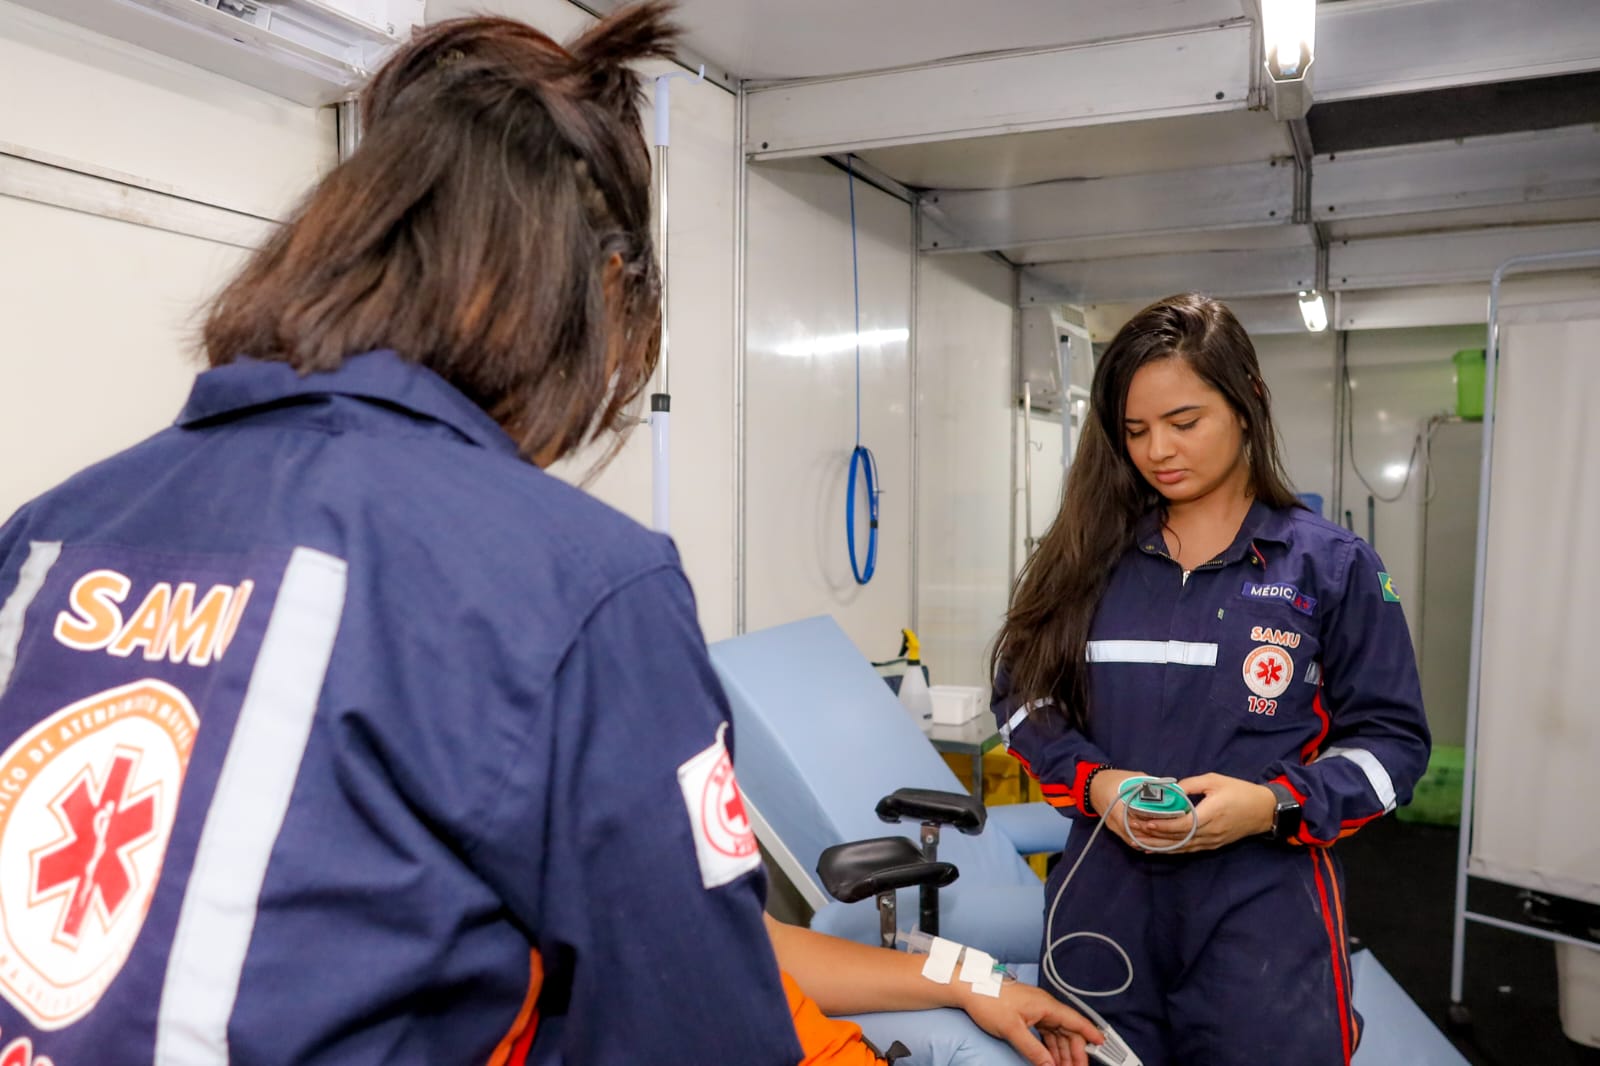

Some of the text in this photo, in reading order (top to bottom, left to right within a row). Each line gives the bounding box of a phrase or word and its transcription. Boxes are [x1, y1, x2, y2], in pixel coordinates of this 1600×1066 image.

[1251, 586, 1297, 601] MÉDIC
[53, 569, 254, 667] SAM
[1251, 626, 1301, 648] SAMU
[1248, 696, 1277, 715] 192
